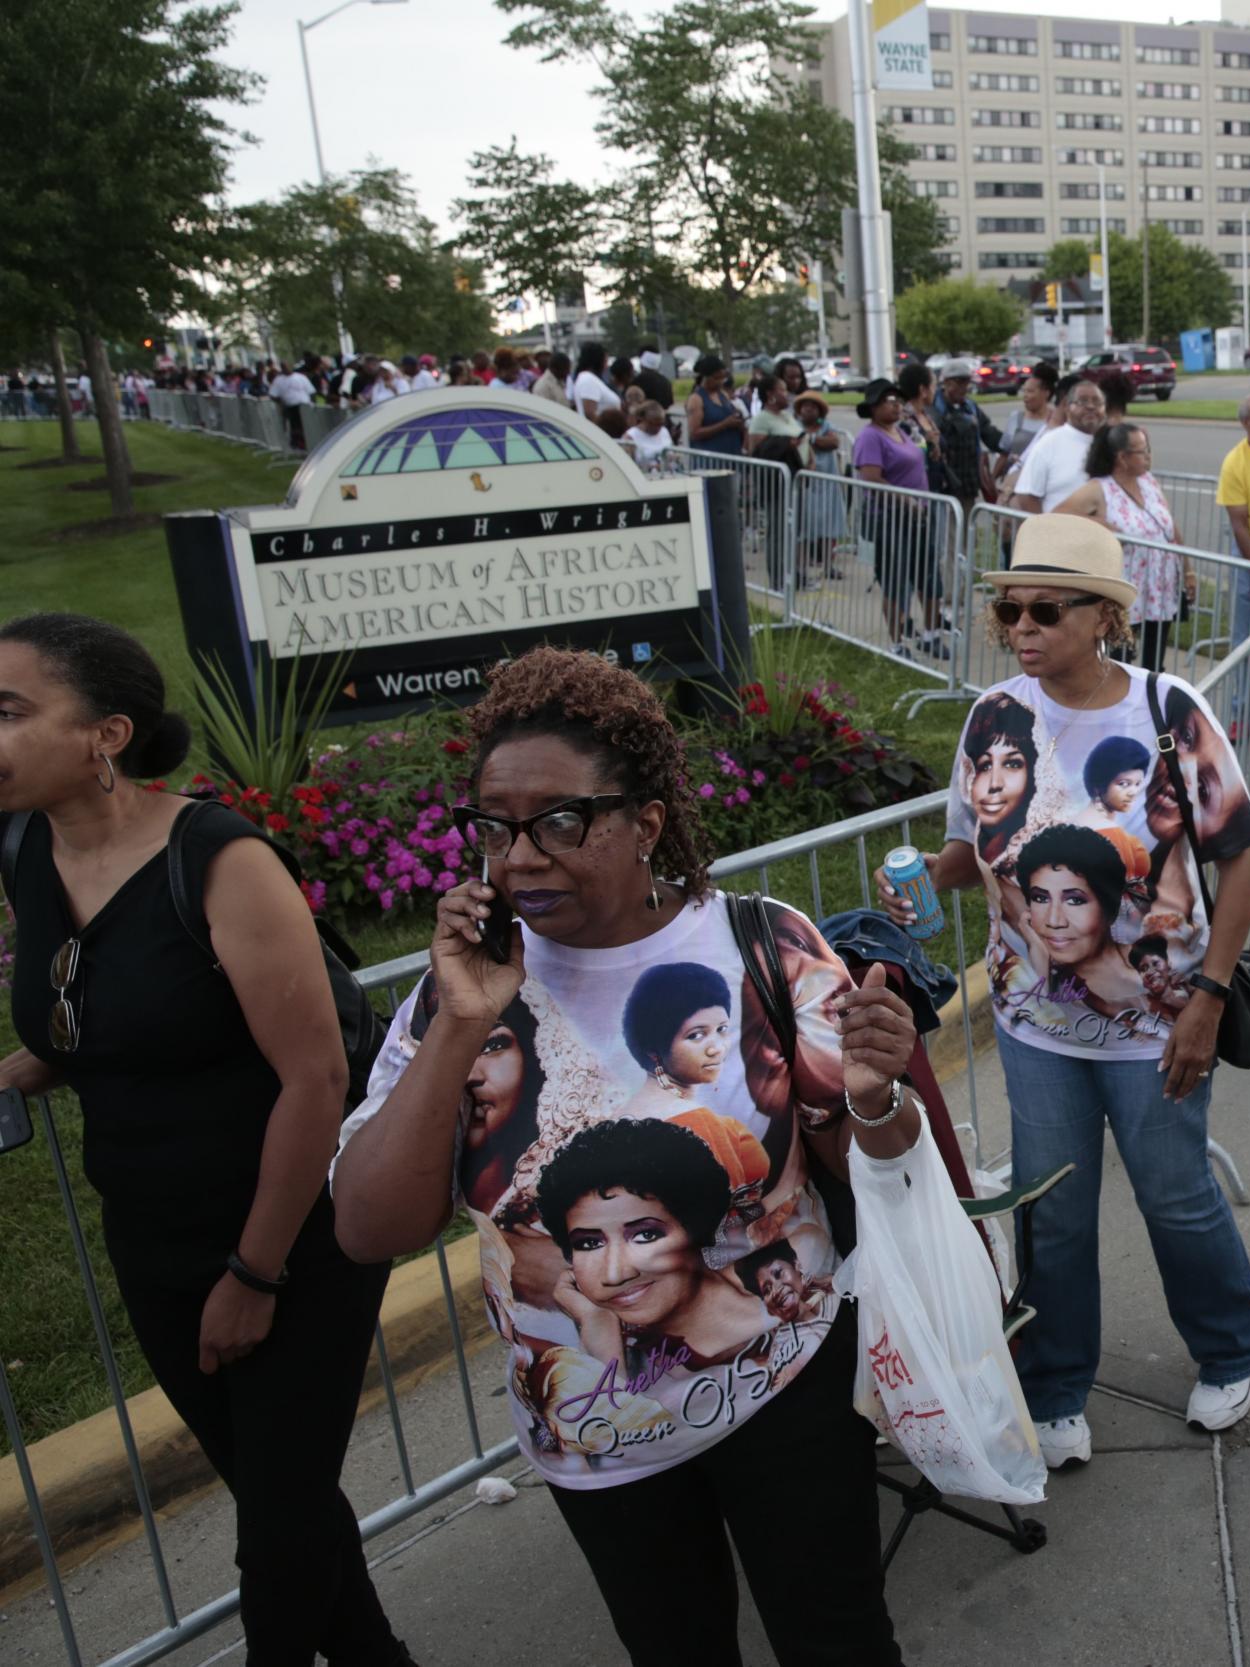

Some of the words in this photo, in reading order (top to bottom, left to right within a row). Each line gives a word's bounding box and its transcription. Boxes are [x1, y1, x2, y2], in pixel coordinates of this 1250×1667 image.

[878, 42, 928, 59] WAYNE
[885, 58, 924, 74] STATE
[270, 525, 445, 556] Charles
[473, 517, 511, 537] H.
[540, 502, 674, 530] Wright
[272, 559, 460, 607] MUSEUM
[472, 557, 495, 590] of
[504, 538, 679, 583] AFRICAN
[281, 594, 506, 649] AMERICAN
[517, 575, 681, 620] HISTORY
[376, 667, 481, 697] Warren
[554, 1336, 692, 1424] Aretha
[575, 1415, 677, 1458] Queen
[679, 1367, 736, 1428] Of
[733, 1321, 805, 1400] Soul
